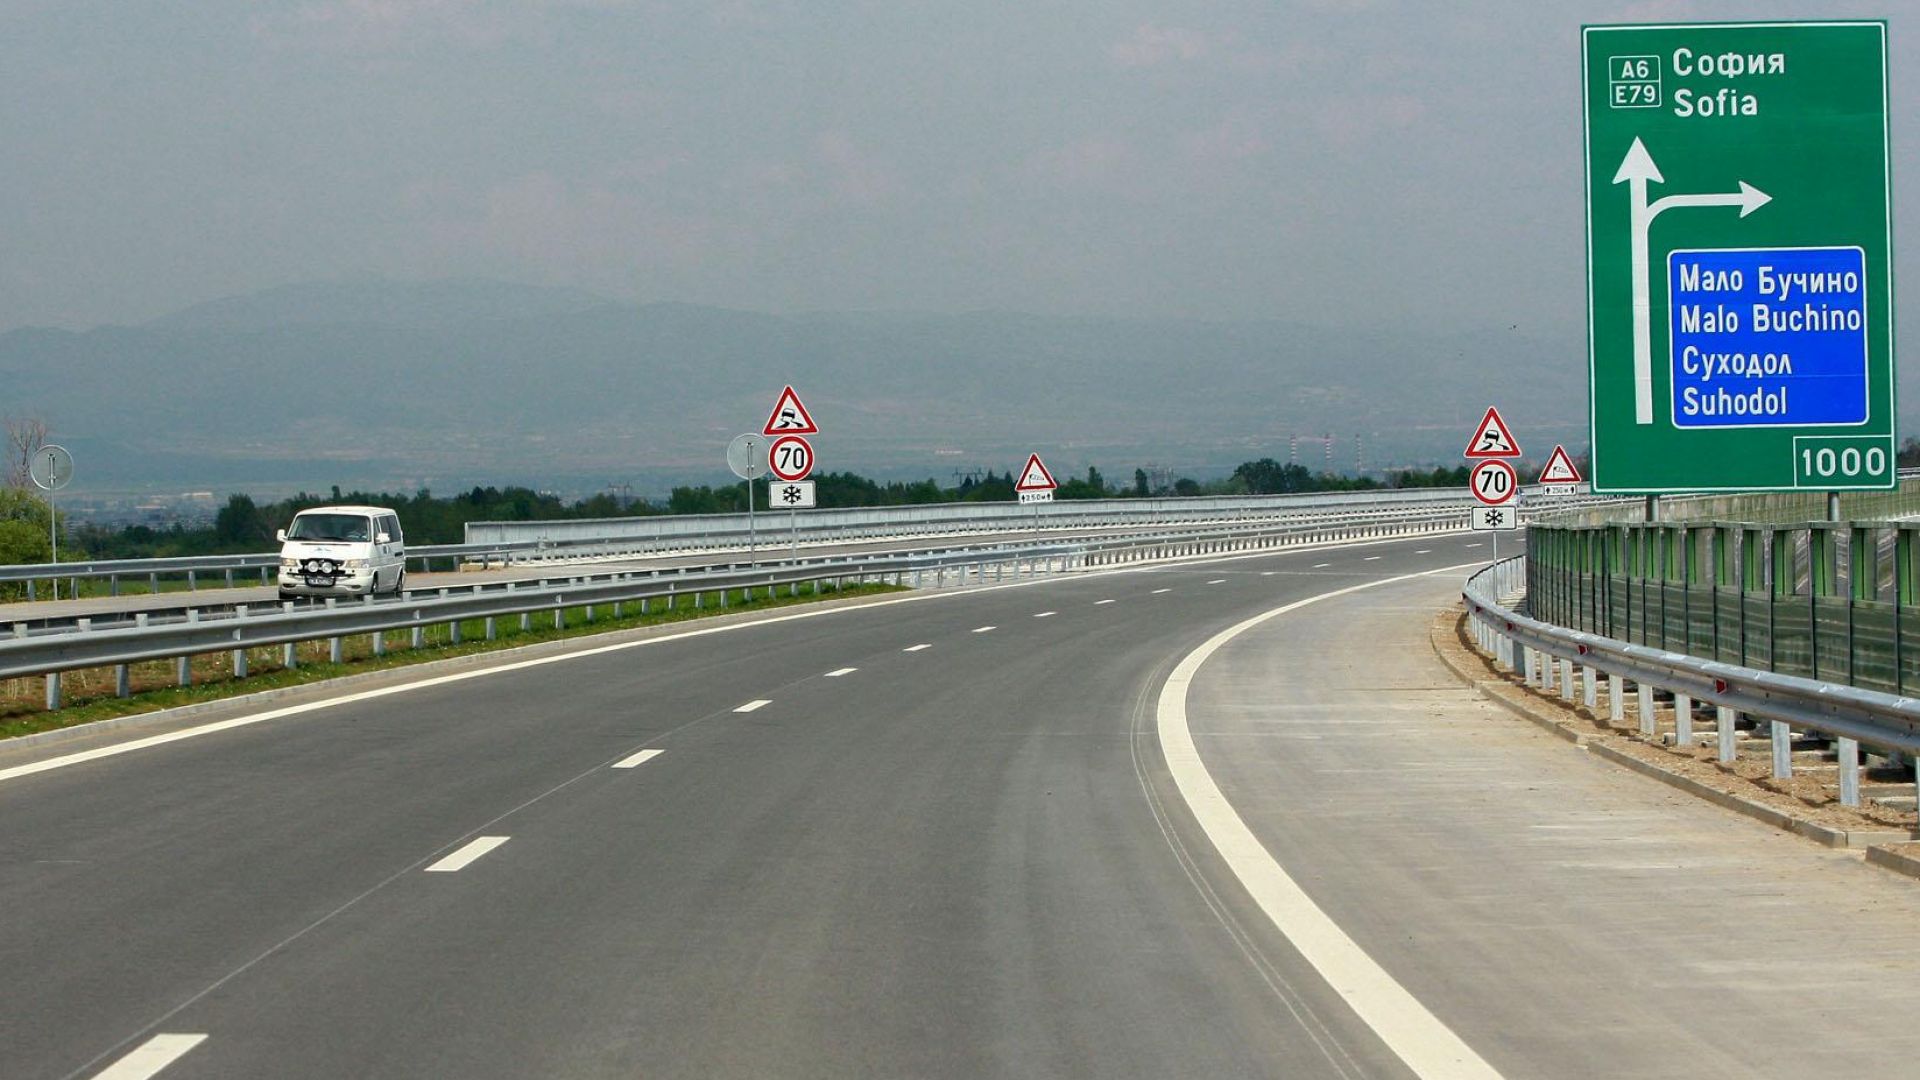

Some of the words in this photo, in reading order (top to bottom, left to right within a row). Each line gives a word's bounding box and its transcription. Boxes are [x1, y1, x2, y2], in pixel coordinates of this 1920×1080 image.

[1621, 60, 1649, 78] A6
[1672, 47, 1786, 79] София
[1615, 84, 1656, 104] E79
[1674, 88, 1759, 117] Sofia
[1680, 263, 1743, 292] Мало
[1758, 266, 1858, 301] Бучино
[1681, 304, 1738, 333] Malo
[1753, 303, 1861, 332] Buchino
[1683, 345, 1792, 381] Суходол
[1683, 386, 1787, 416] Suhodol
[780, 447, 805, 470] 70
[1802, 447, 1885, 477] 1000
[1481, 470, 1506, 494] 70
